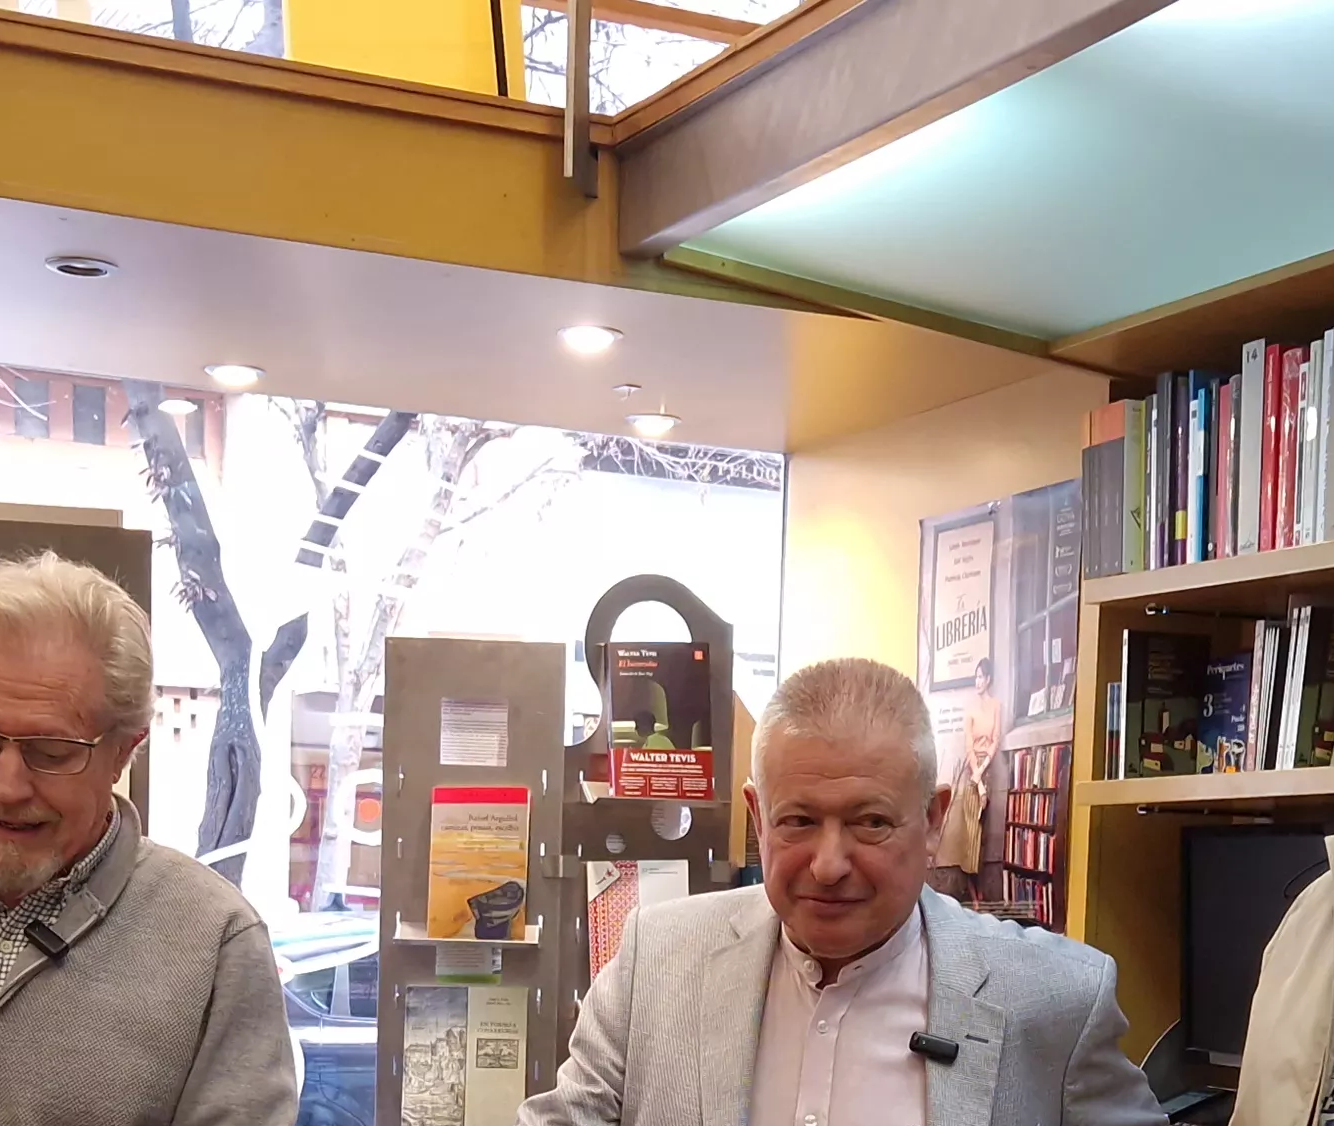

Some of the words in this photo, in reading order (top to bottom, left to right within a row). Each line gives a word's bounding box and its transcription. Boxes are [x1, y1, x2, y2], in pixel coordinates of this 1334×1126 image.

[936, 599, 988, 652] LIBRERÍA
[1202, 693, 1214, 718] 3
[630, 752, 668, 763] WALTER
[669, 753, 697, 763] TEVIS
